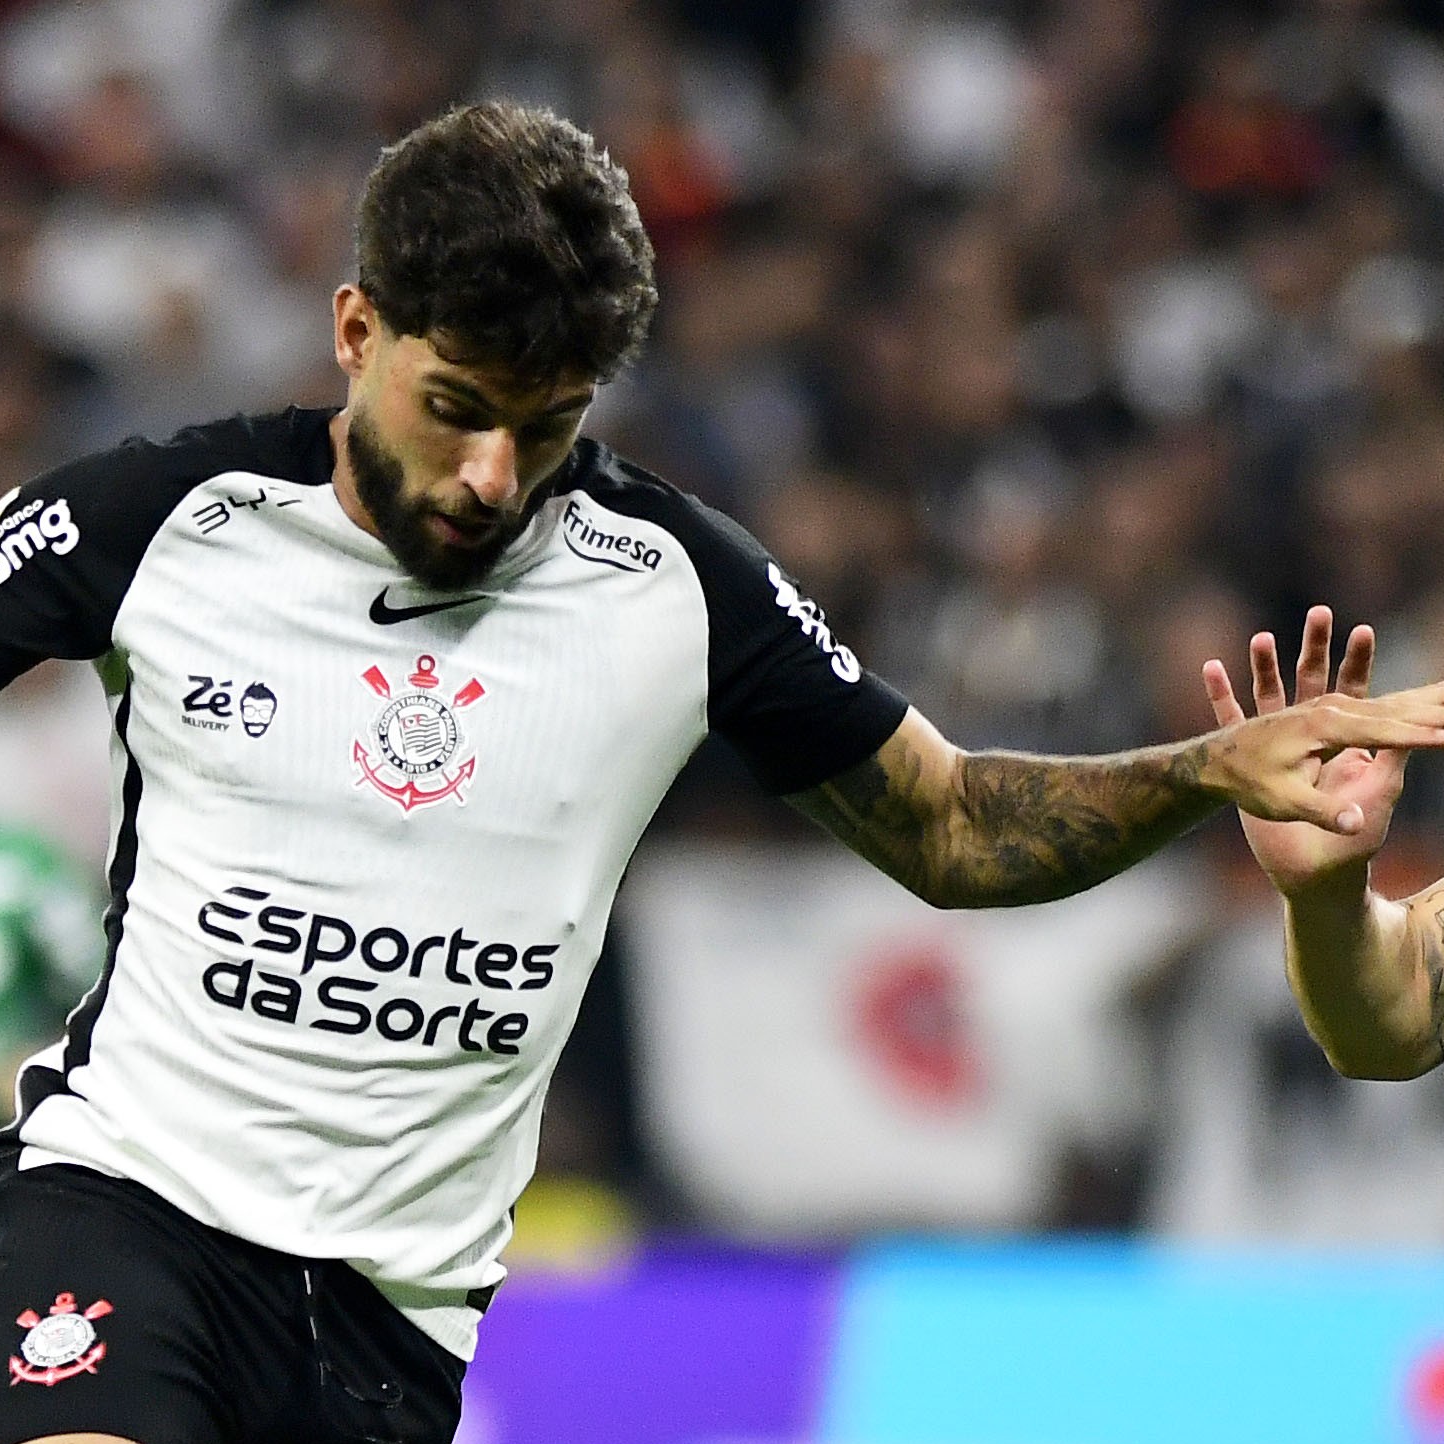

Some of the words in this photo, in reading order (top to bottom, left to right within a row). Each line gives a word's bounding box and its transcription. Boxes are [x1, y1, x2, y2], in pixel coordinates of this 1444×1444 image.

[563, 500, 662, 571] Frimesa
[181, 714, 230, 732] DELIVERY
[182, 674, 233, 717] Zé
[198, 886, 561, 990] Esportes
[309, 975, 529, 1055] Sorte
